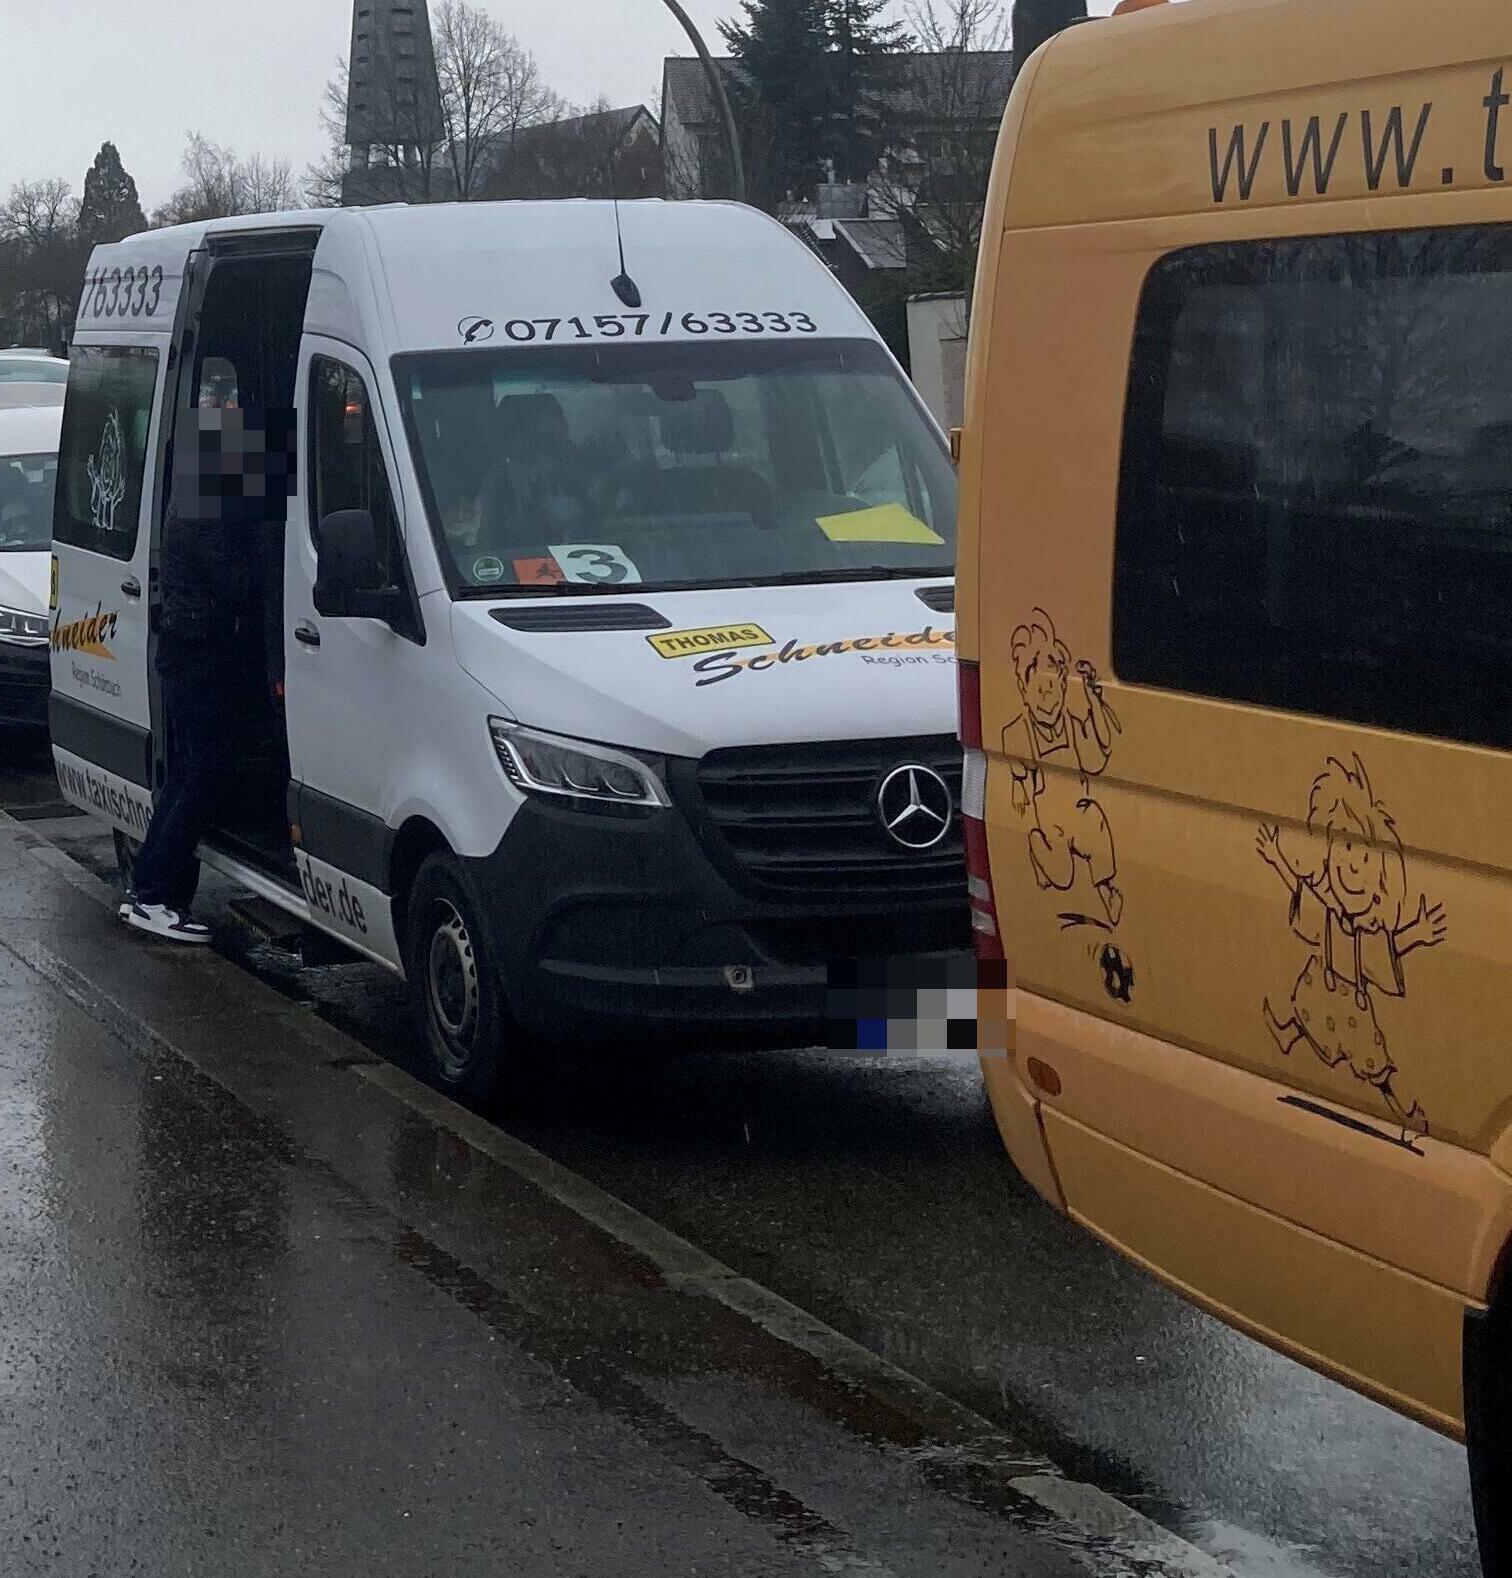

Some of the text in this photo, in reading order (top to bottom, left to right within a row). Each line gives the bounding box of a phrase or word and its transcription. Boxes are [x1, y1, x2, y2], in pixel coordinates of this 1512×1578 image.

[1208, 66, 1511, 203] www.t
[81, 264, 163, 319] /63333
[567, 549, 629, 584] 3
[659, 629, 760, 652] THOMAS
[861, 655, 930, 668] Region
